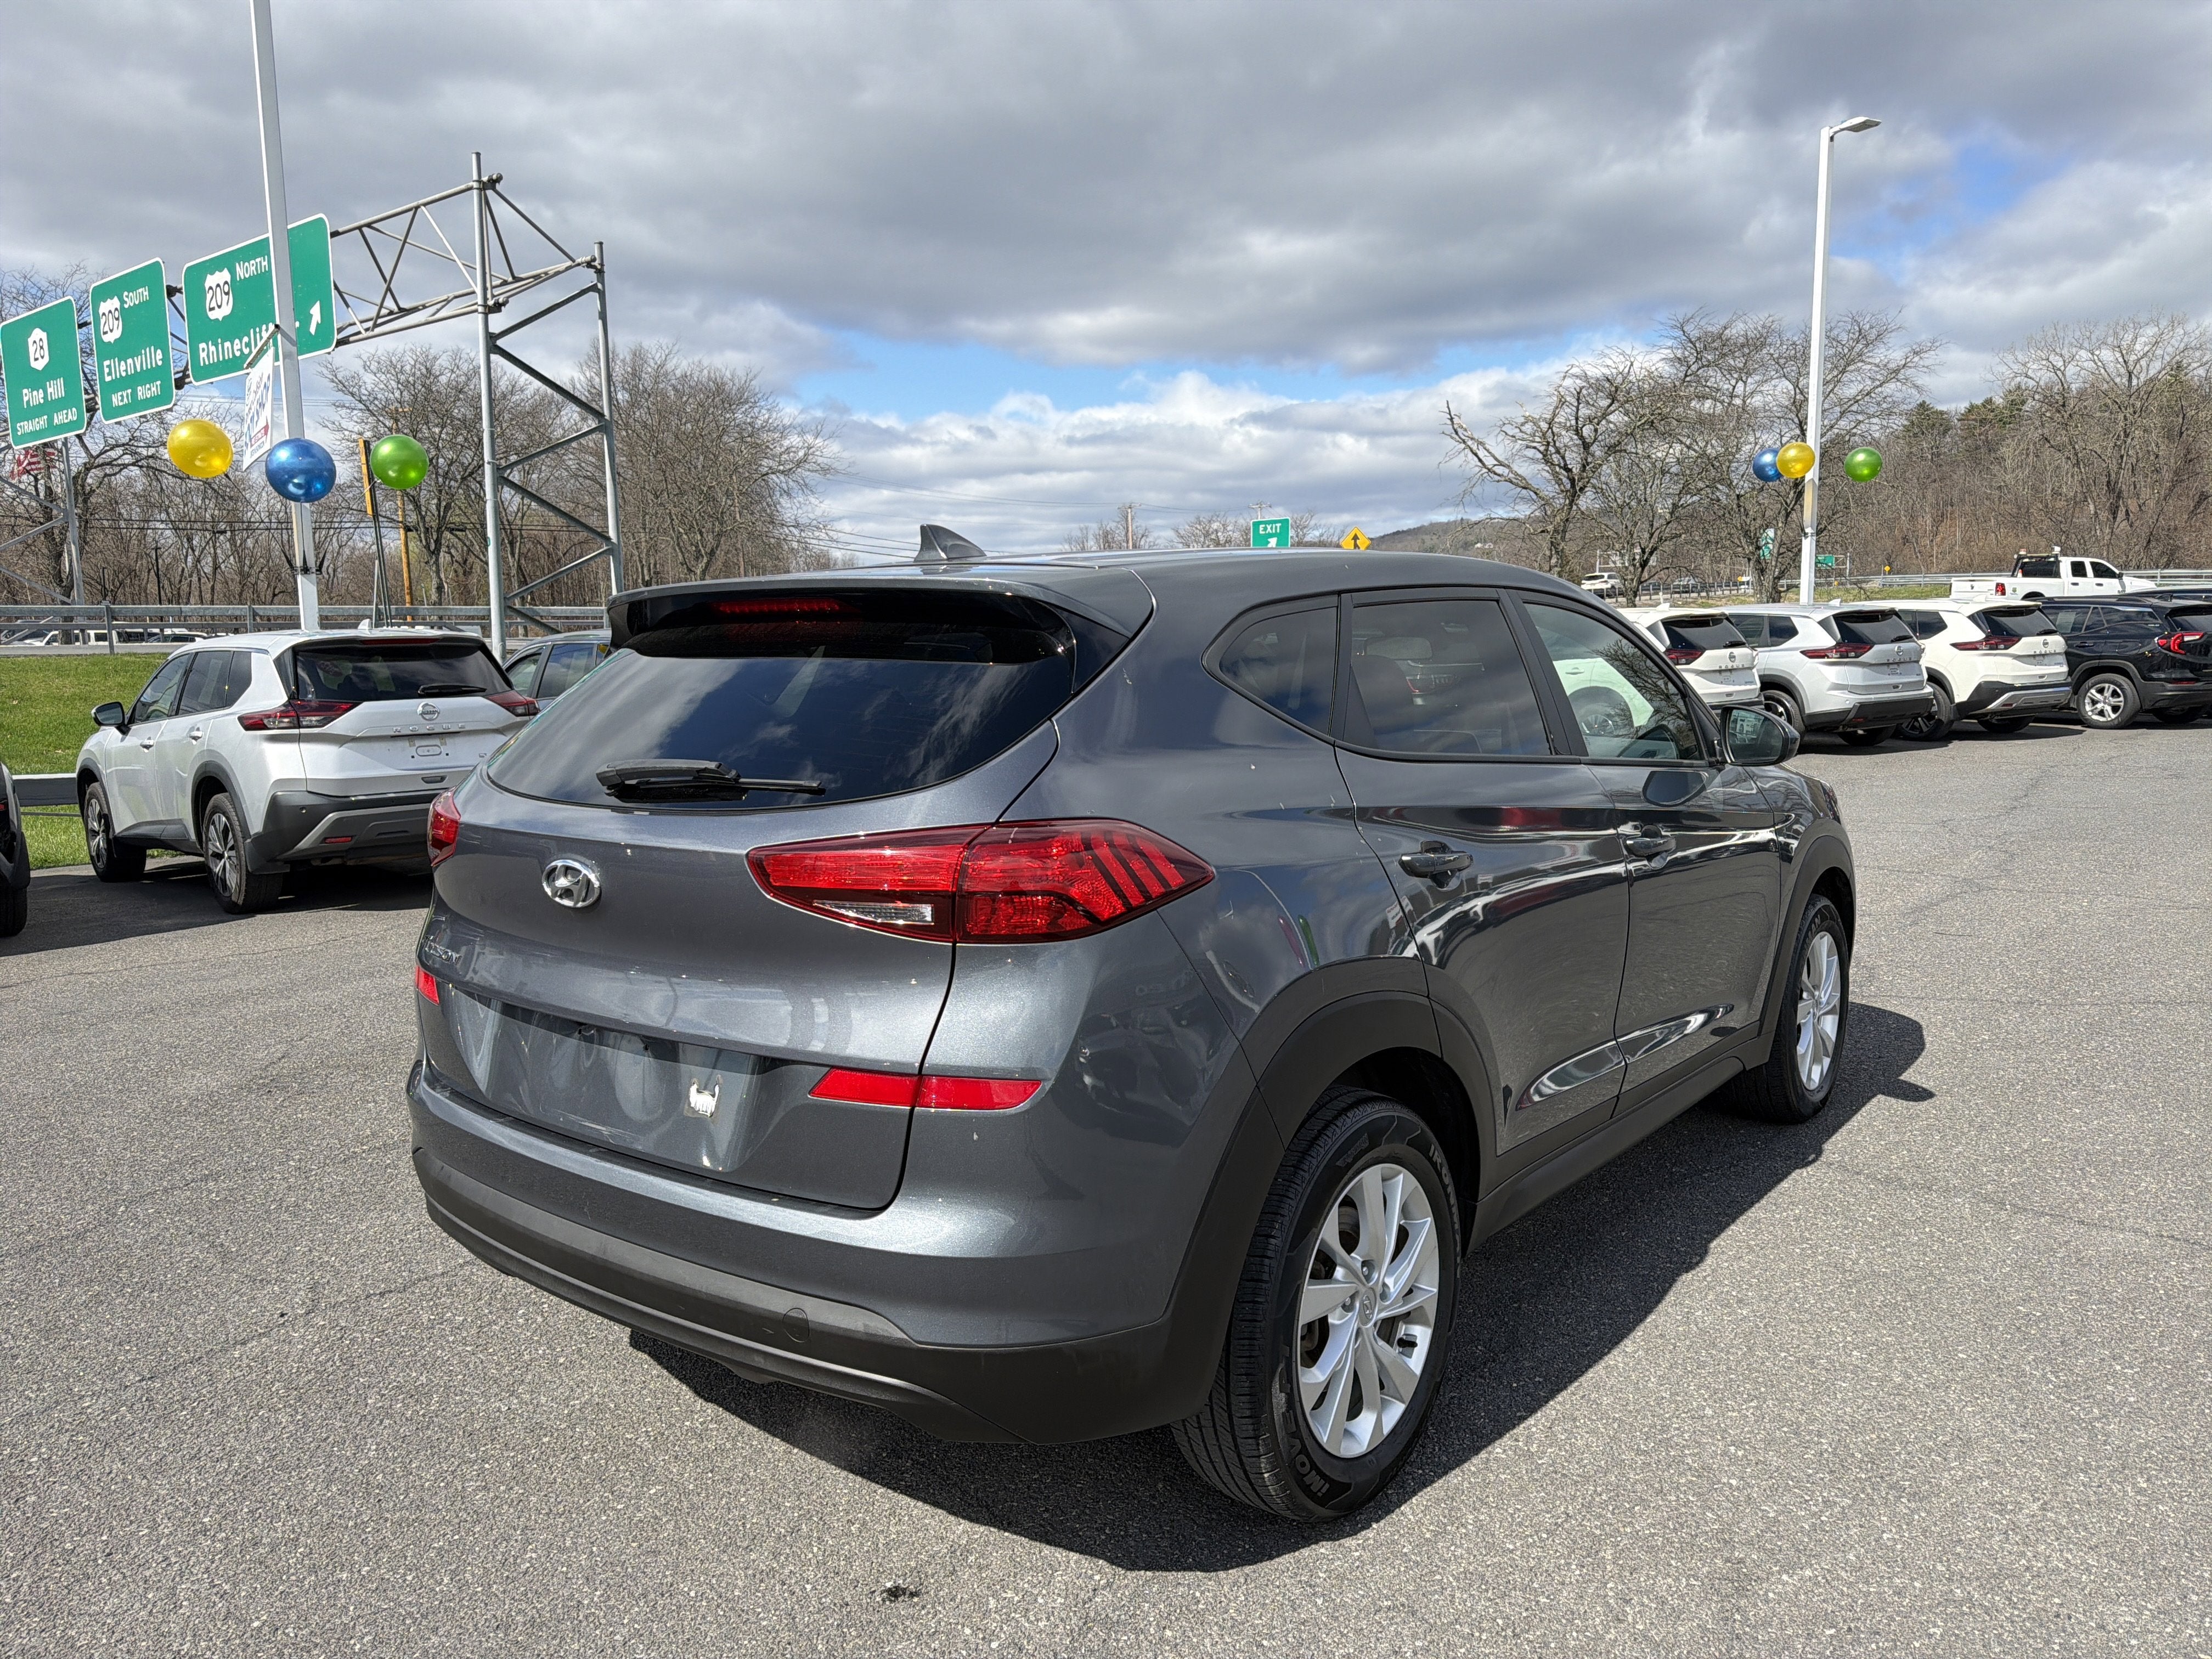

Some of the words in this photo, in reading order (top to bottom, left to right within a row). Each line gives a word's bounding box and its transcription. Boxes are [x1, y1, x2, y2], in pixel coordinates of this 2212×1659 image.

[236, 255, 268, 281] NORTH
[123, 286, 149, 308] SOUTH
[207, 280, 230, 312] 209
[101, 307, 120, 335] 209
[32, 337, 45, 362] 28
[103, 346, 163, 382] Ellenville
[22, 388, 44, 408] Pine
[47, 377, 65, 401] Hill
[112, 389, 132, 407] NEXT
[137, 381, 161, 400] RIGHT
[16, 415, 48, 436] STRAIGHT
[54, 407, 77, 426] AHEAD
[1259, 523, 1282, 534] EXIT
[393, 723, 466, 733] ROGUE
